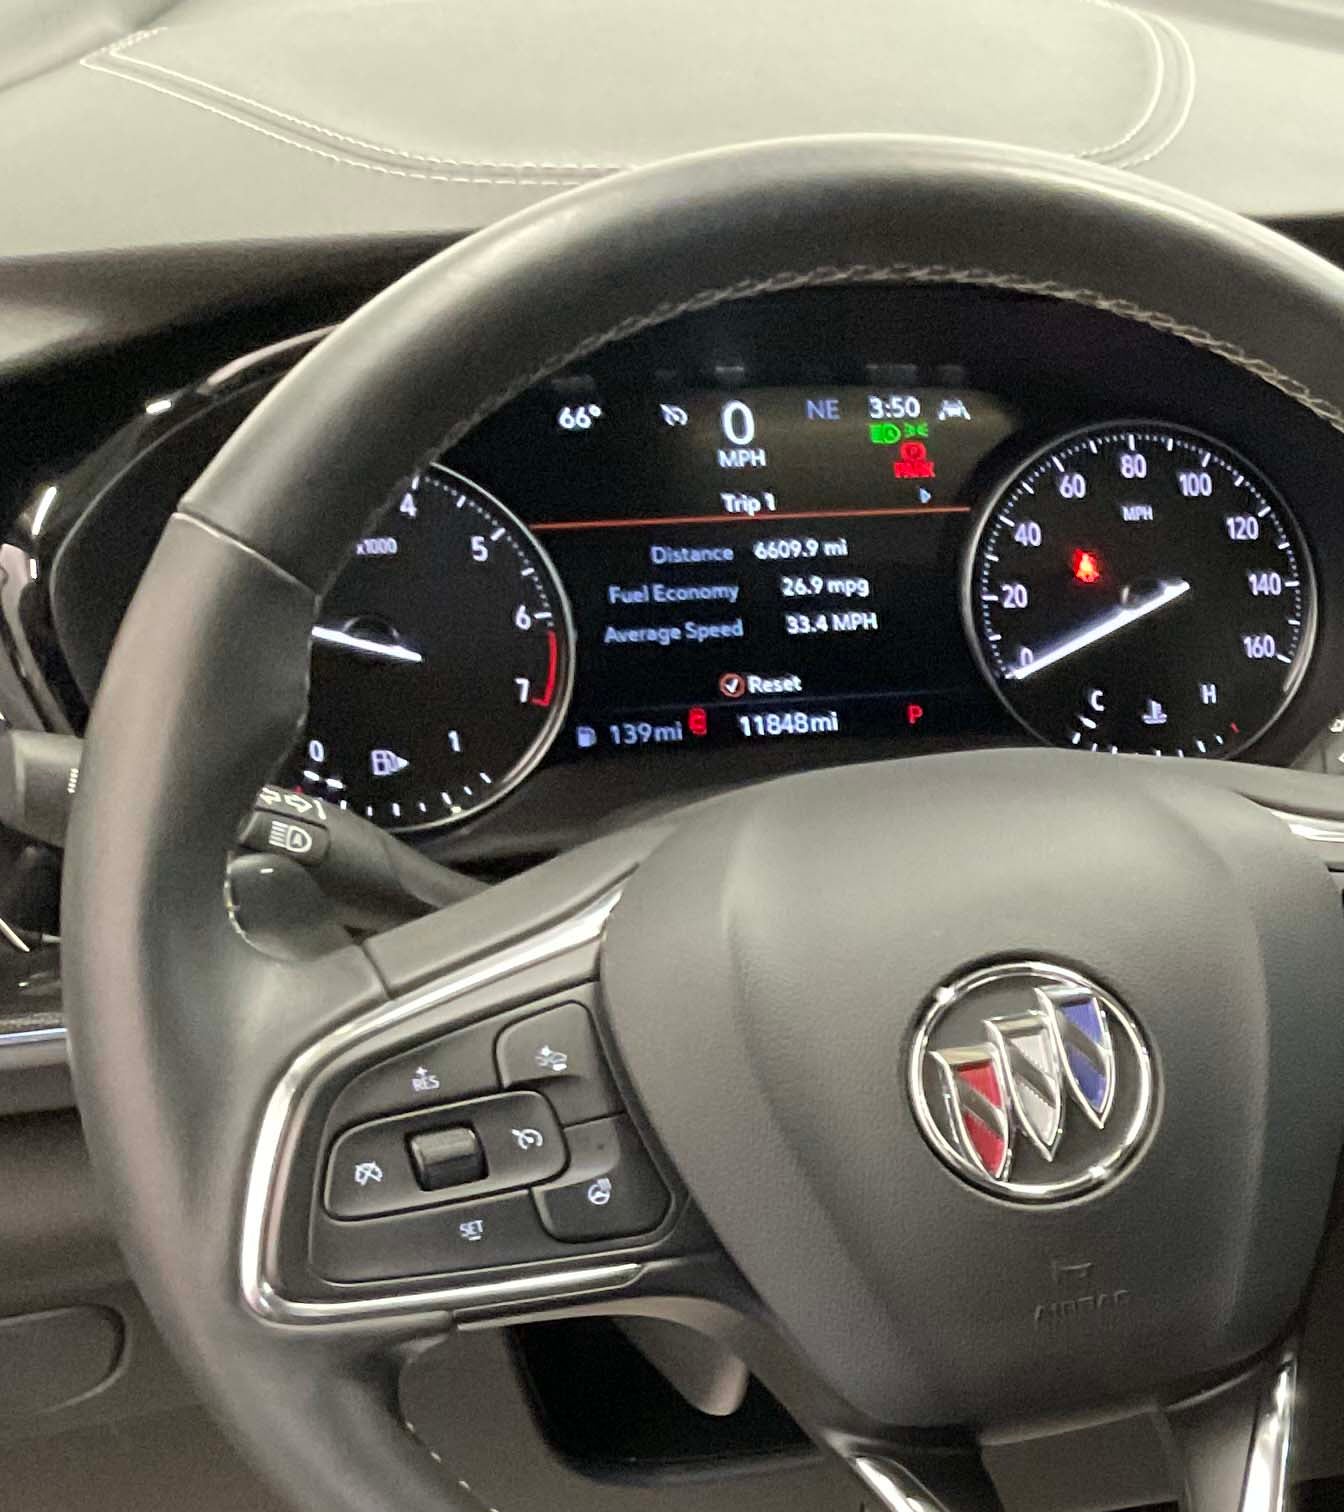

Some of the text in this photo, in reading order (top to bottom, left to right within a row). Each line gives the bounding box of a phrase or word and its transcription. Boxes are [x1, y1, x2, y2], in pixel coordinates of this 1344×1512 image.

[805, 400, 840, 420] NE
[869, 395, 921, 419] 3:50
[721, 401, 755, 445] 0
[718, 449, 767, 468] MPH
[1120, 453, 1147, 479] 80
[1059, 473, 1087, 499] 60
[1178, 472, 1213, 497] 100
[399, 493, 417, 518] 4
[721, 492, 776, 517] Trip 1
[1121, 505, 1154, 521] MPH
[1014, 522, 1042, 547] 40
[1226, 516, 1259, 540] 120
[471, 537, 489, 562] 5
[650, 545, 734, 565] Distance
[752, 538, 848, 561] 6609.9 mi
[608, 581, 739, 603] Fuel Economy
[781, 576, 869, 598] 26.9 mpg
[1249, 572, 1282, 596] 140
[1001, 584, 1028, 609] 20
[514, 605, 533, 630] 6
[785, 612, 878, 635] 33.4 MPH
[604, 619, 744, 646] Average Speed
[1243, 634, 1276, 659] 160
[514, 677, 530, 704] 7
[747, 675, 802, 694] Reset
[1201, 684, 1217, 704] H
[1090, 690, 1105, 712] C
[907, 704, 924, 724] P
[308, 741, 325, 764] 0
[447, 730, 464, 752] 1
